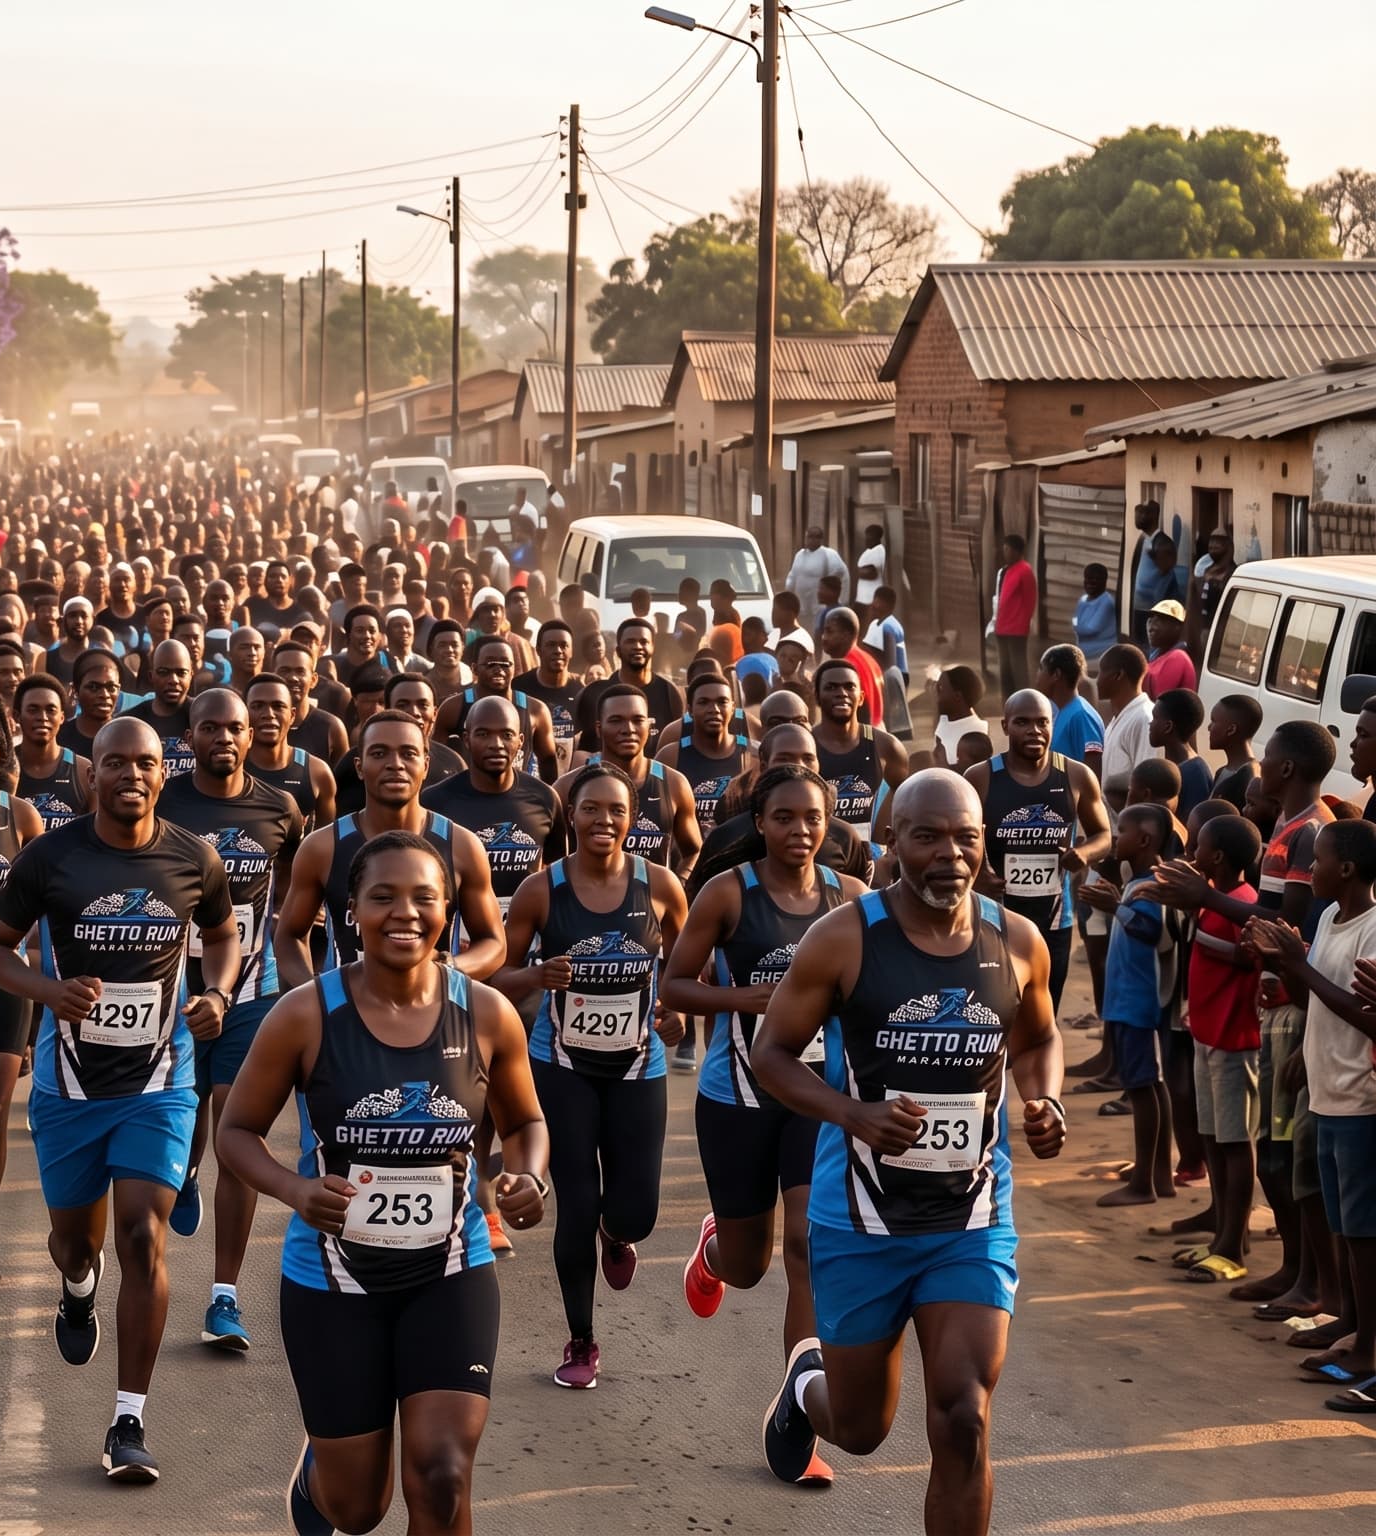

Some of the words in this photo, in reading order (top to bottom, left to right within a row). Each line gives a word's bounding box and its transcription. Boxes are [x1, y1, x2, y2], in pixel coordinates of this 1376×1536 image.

[1009, 867, 1055, 885] 2267
[74, 924, 142, 941] GHETTO
[146, 925, 181, 941] RUN
[622, 959, 651, 975] RUN
[86, 1002, 155, 1029] 4297
[570, 1011, 633, 1037] 4297
[875, 1030, 959, 1053] GHETTO
[965, 1032, 1003, 1054] RUN
[336, 1125, 424, 1145] GHETTO
[429, 1125, 475, 1145] RUN
[910, 1119, 970, 1151] 253
[366, 1192, 434, 1226] 253
